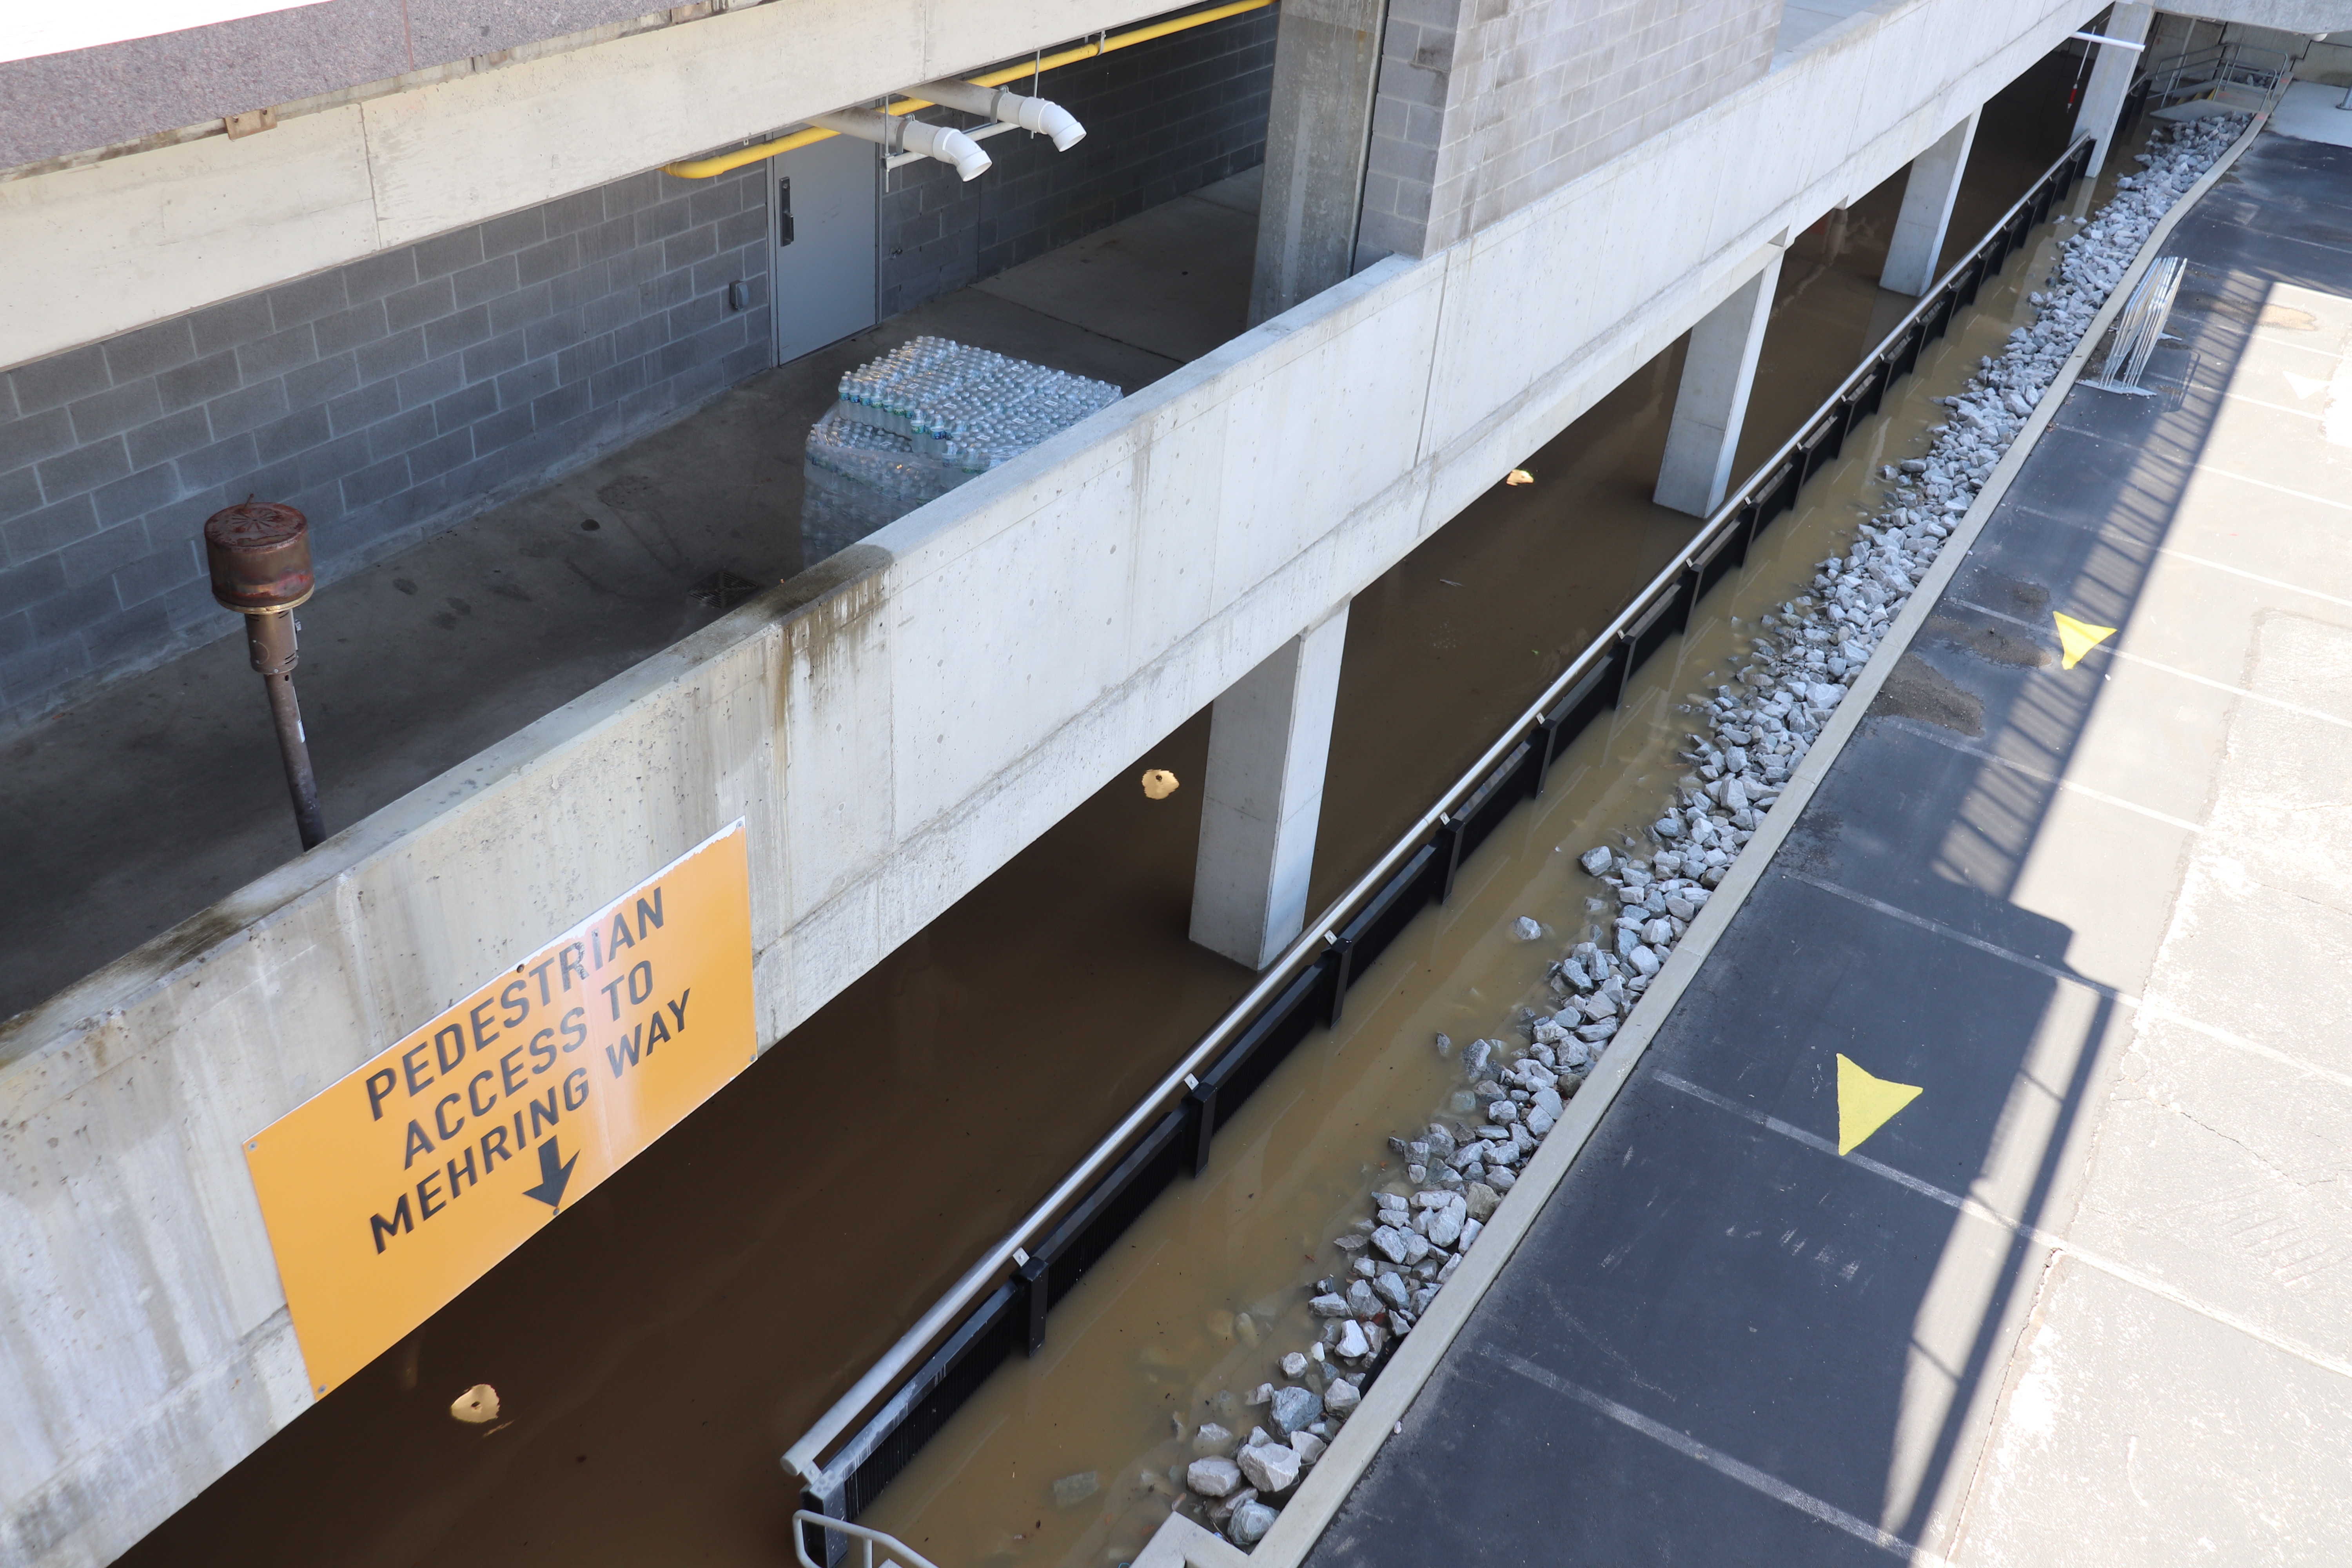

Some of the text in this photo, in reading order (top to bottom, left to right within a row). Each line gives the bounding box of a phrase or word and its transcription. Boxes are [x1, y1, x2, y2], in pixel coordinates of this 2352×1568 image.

[365, 887, 664, 1122] PEDESTRIAN
[370, 987, 690, 1255] MEHRING WAY
[404, 960, 653, 1171] ACCESS TO
